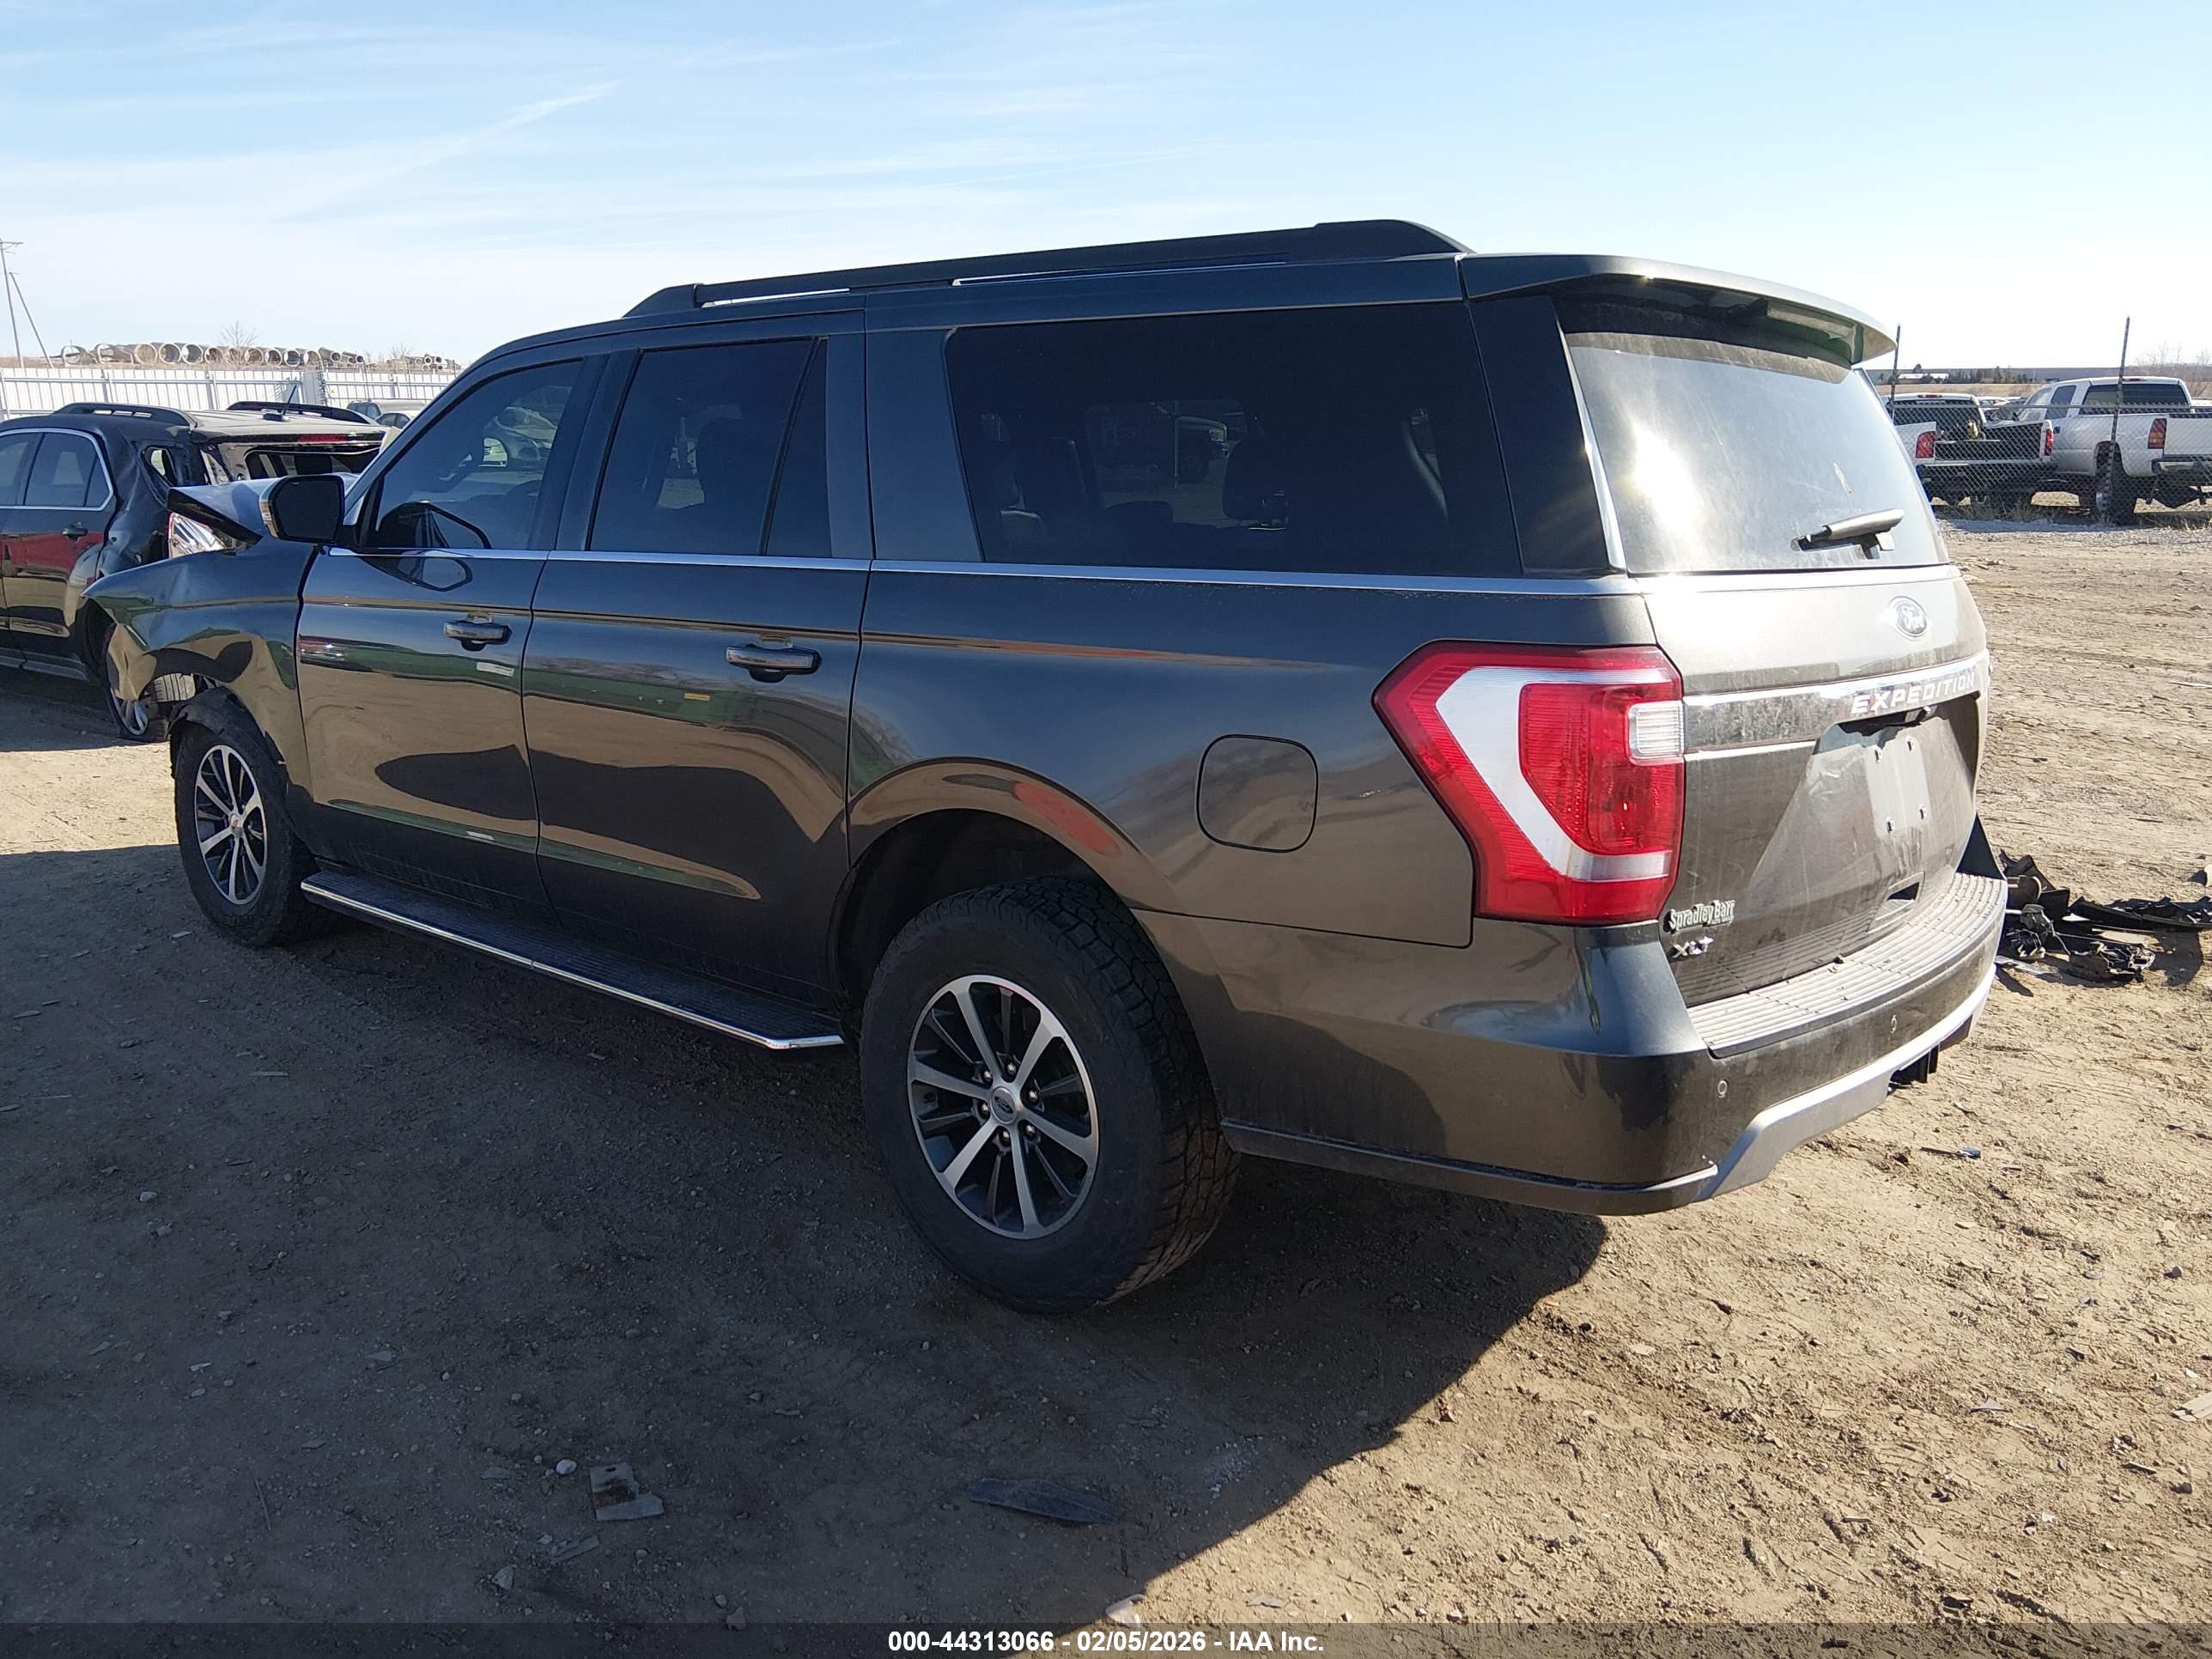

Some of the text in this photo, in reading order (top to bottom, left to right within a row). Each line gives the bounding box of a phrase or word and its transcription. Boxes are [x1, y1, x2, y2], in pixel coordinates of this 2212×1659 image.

[1850, 671, 1977, 714] EXPEDITION
[1668, 899, 1735, 931] Spradley Barr
[1671, 936, 1714, 958] XLT
